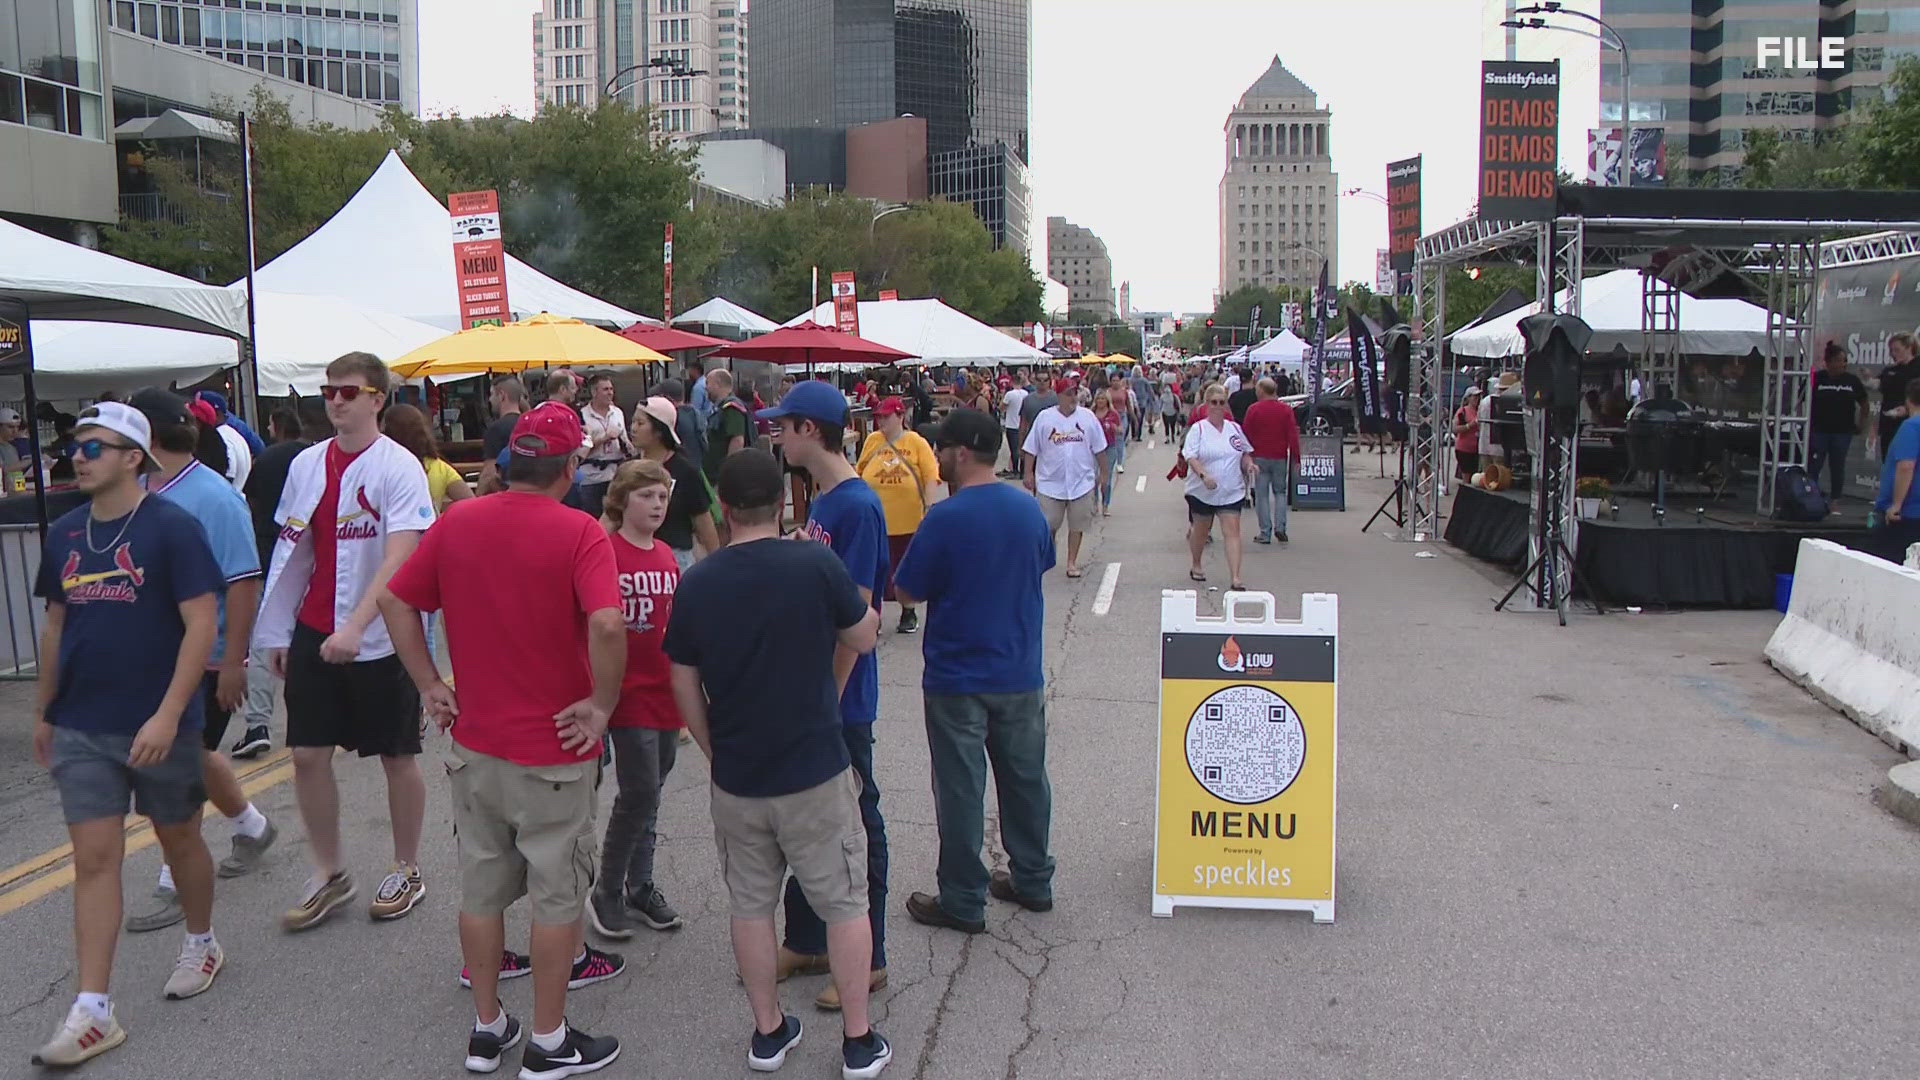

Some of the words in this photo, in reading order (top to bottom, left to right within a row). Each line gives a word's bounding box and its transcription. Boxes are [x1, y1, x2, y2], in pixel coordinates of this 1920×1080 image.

[1485, 72, 1557, 88] Smithfield
[1486, 99, 1556, 128] DEMOS
[1485, 134, 1555, 163] DEMOS
[1484, 169, 1554, 199] DEMOS
[457, 217, 493, 227] PAPPY'S
[463, 255, 497, 275] MENU
[464, 279, 473, 288] STL
[473, 278, 487, 287] STYLE
[483, 291, 500, 300] TURKEY
[0, 328, 18, 342] OYS
[1357, 335, 1374, 416] Smithfield
[1300, 458, 1315, 467] WIN
[1317, 458, 1335, 467] FREE
[1300, 466, 1335, 477] BACON
[621, 597, 654, 622] UP
[1191, 811, 1296, 839] MENU
[1194, 858, 1292, 889] speckles
